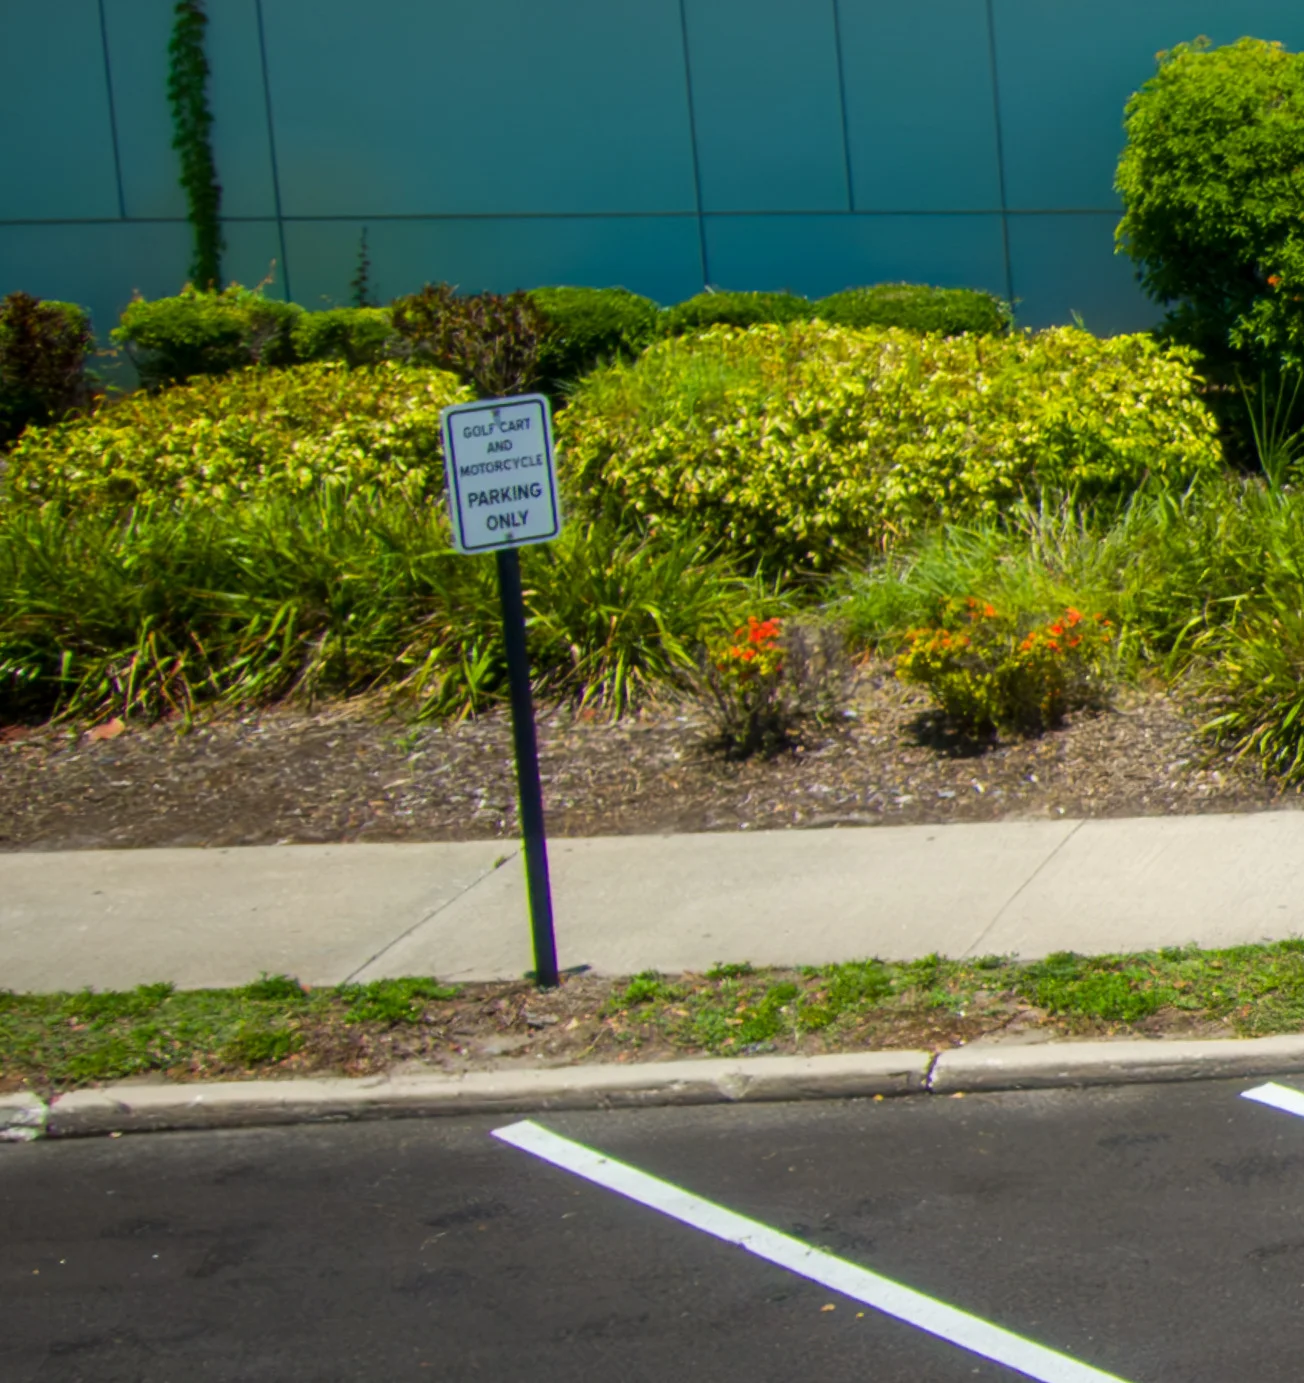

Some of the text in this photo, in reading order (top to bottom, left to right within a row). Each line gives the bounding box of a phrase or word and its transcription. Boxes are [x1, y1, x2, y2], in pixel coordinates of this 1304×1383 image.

[463, 417, 530, 439] GOLF CART
[487, 439, 513, 453] AND
[460, 453, 543, 477] MOTORCYCLE
[467, 482, 542, 508] PARKING
[486, 510, 528, 531] ONLY
